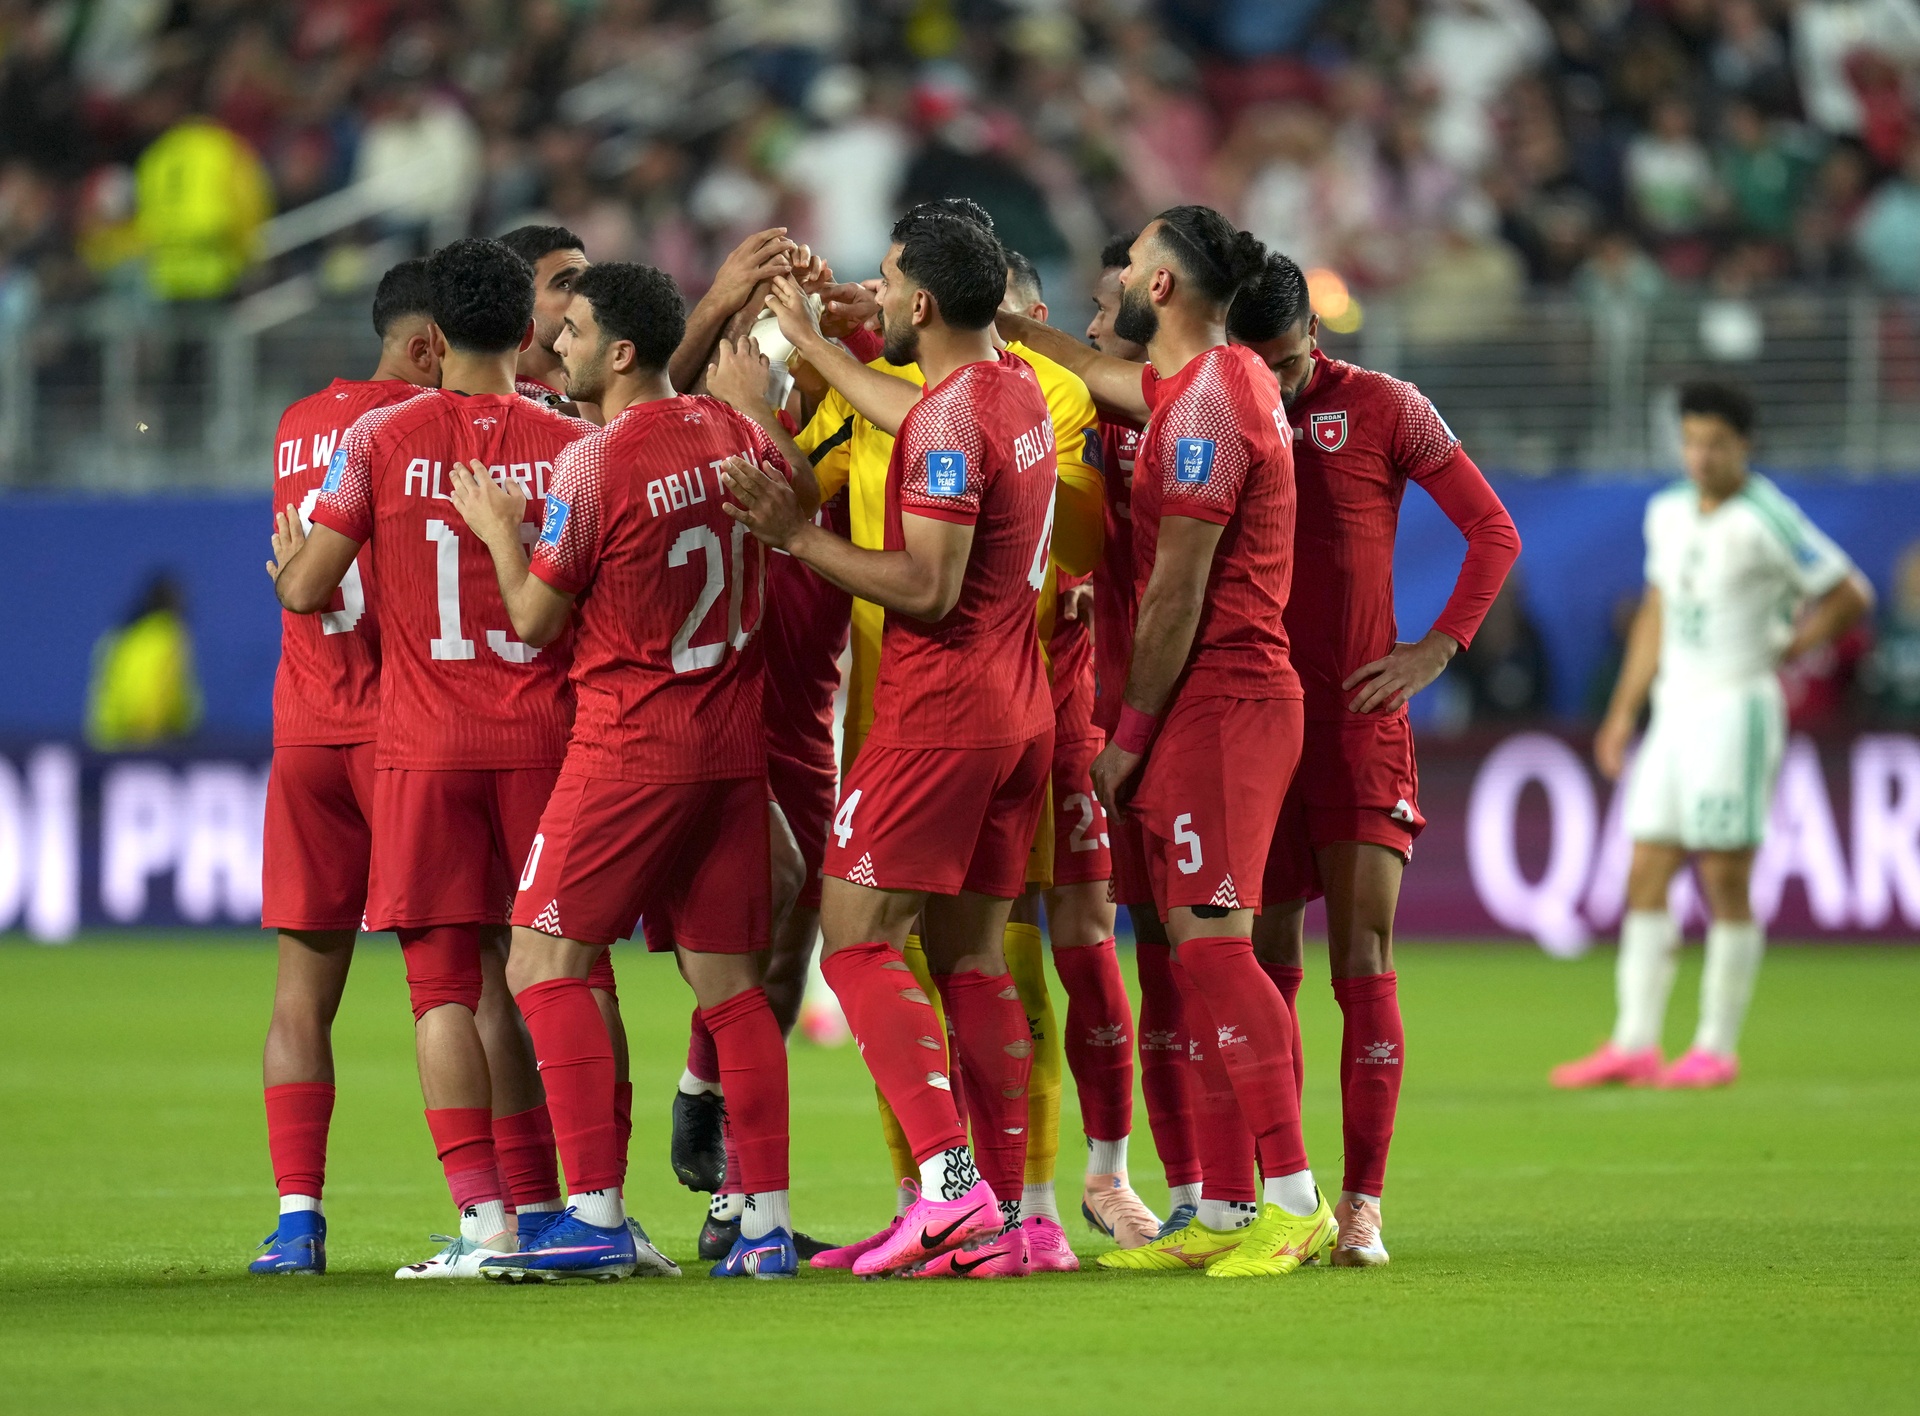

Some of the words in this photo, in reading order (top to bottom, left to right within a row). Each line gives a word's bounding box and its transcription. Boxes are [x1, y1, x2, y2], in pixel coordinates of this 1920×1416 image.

[1316, 414, 1342, 422] JORDAN
[278, 428, 350, 479] OLW
[1014, 426, 1045, 473] ABU
[404, 458, 453, 503] AL
[647, 467, 707, 518] ABU
[938, 478, 955, 486] PEACE
[668, 519, 766, 674] 20
[834, 789, 863, 849] 4
[1174, 813, 1203, 875] 5
[1086, 1035, 1127, 1047] KELME
[1218, 1035, 1248, 1048] ELME
[1355, 1057, 1399, 1065] KELME
